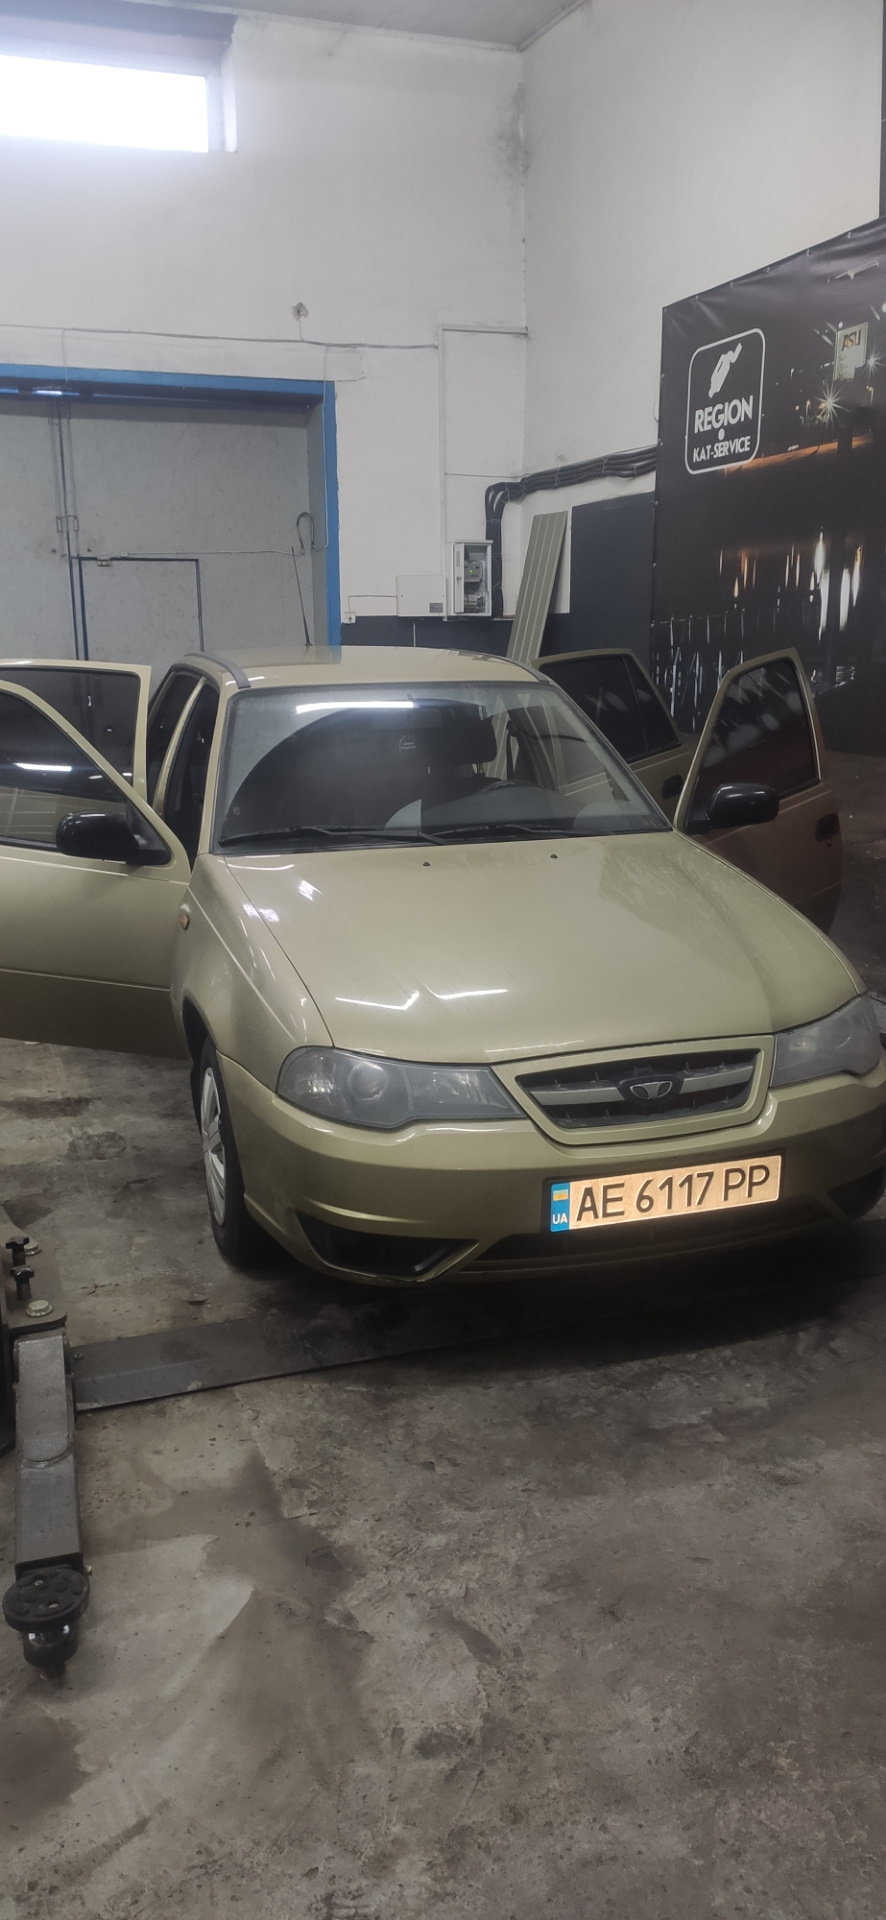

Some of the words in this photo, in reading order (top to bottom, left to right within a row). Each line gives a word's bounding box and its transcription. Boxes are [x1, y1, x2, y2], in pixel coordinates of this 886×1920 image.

[694, 395, 753, 433] REGION
[693, 436, 751, 463] KAT-SERVICE
[576, 1182, 625, 1221] AE
[636, 1171, 714, 1213] 6117
[723, 1164, 771, 1201] PP
[552, 1213, 568, 1224] UA
